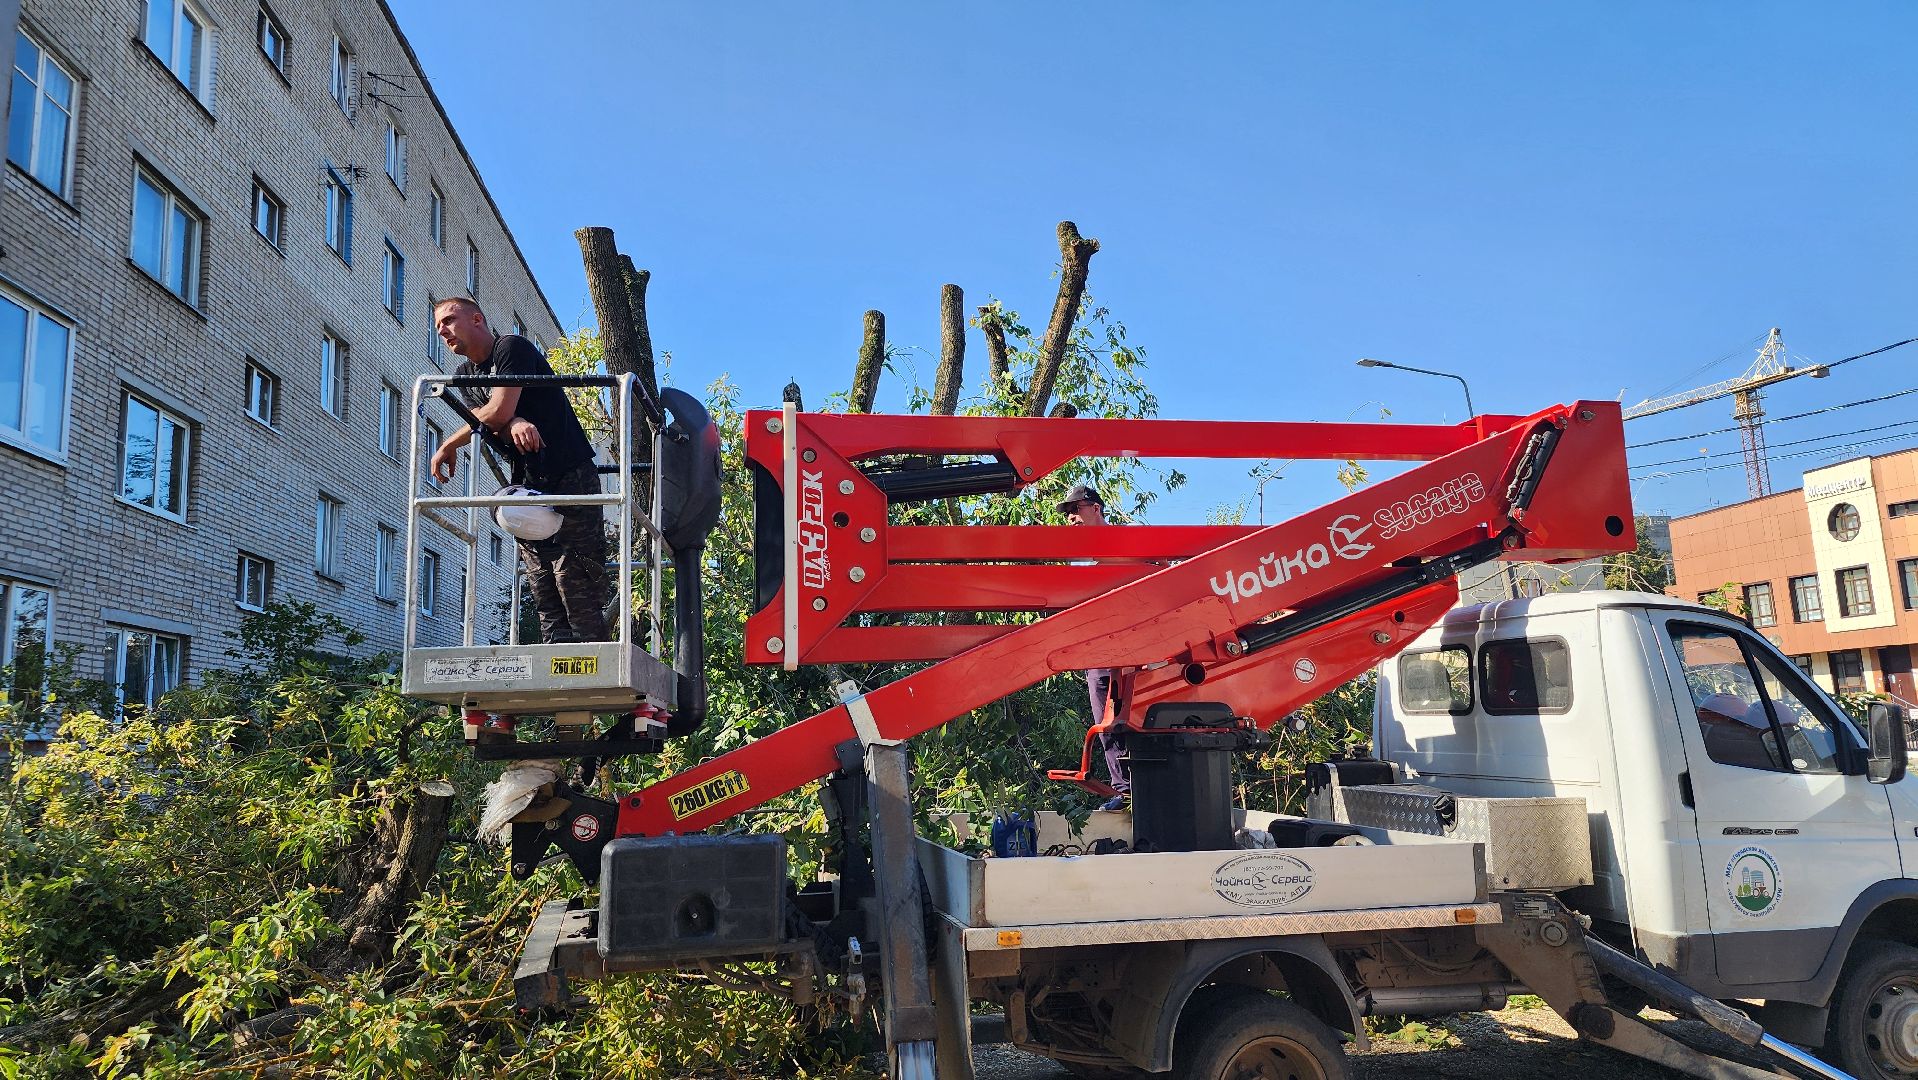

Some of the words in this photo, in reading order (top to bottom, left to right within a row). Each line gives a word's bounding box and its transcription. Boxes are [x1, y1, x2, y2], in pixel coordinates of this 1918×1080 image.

[1209, 543, 1330, 604] Чайка
[553, 661, 569, 674] 260
[571, 661, 582, 674] KG
[673, 787, 707, 816] 260
[704, 779, 727, 803] KG
[1215, 877, 1251, 887] Чайка
[1271, 875, 1313, 886] Сервис
